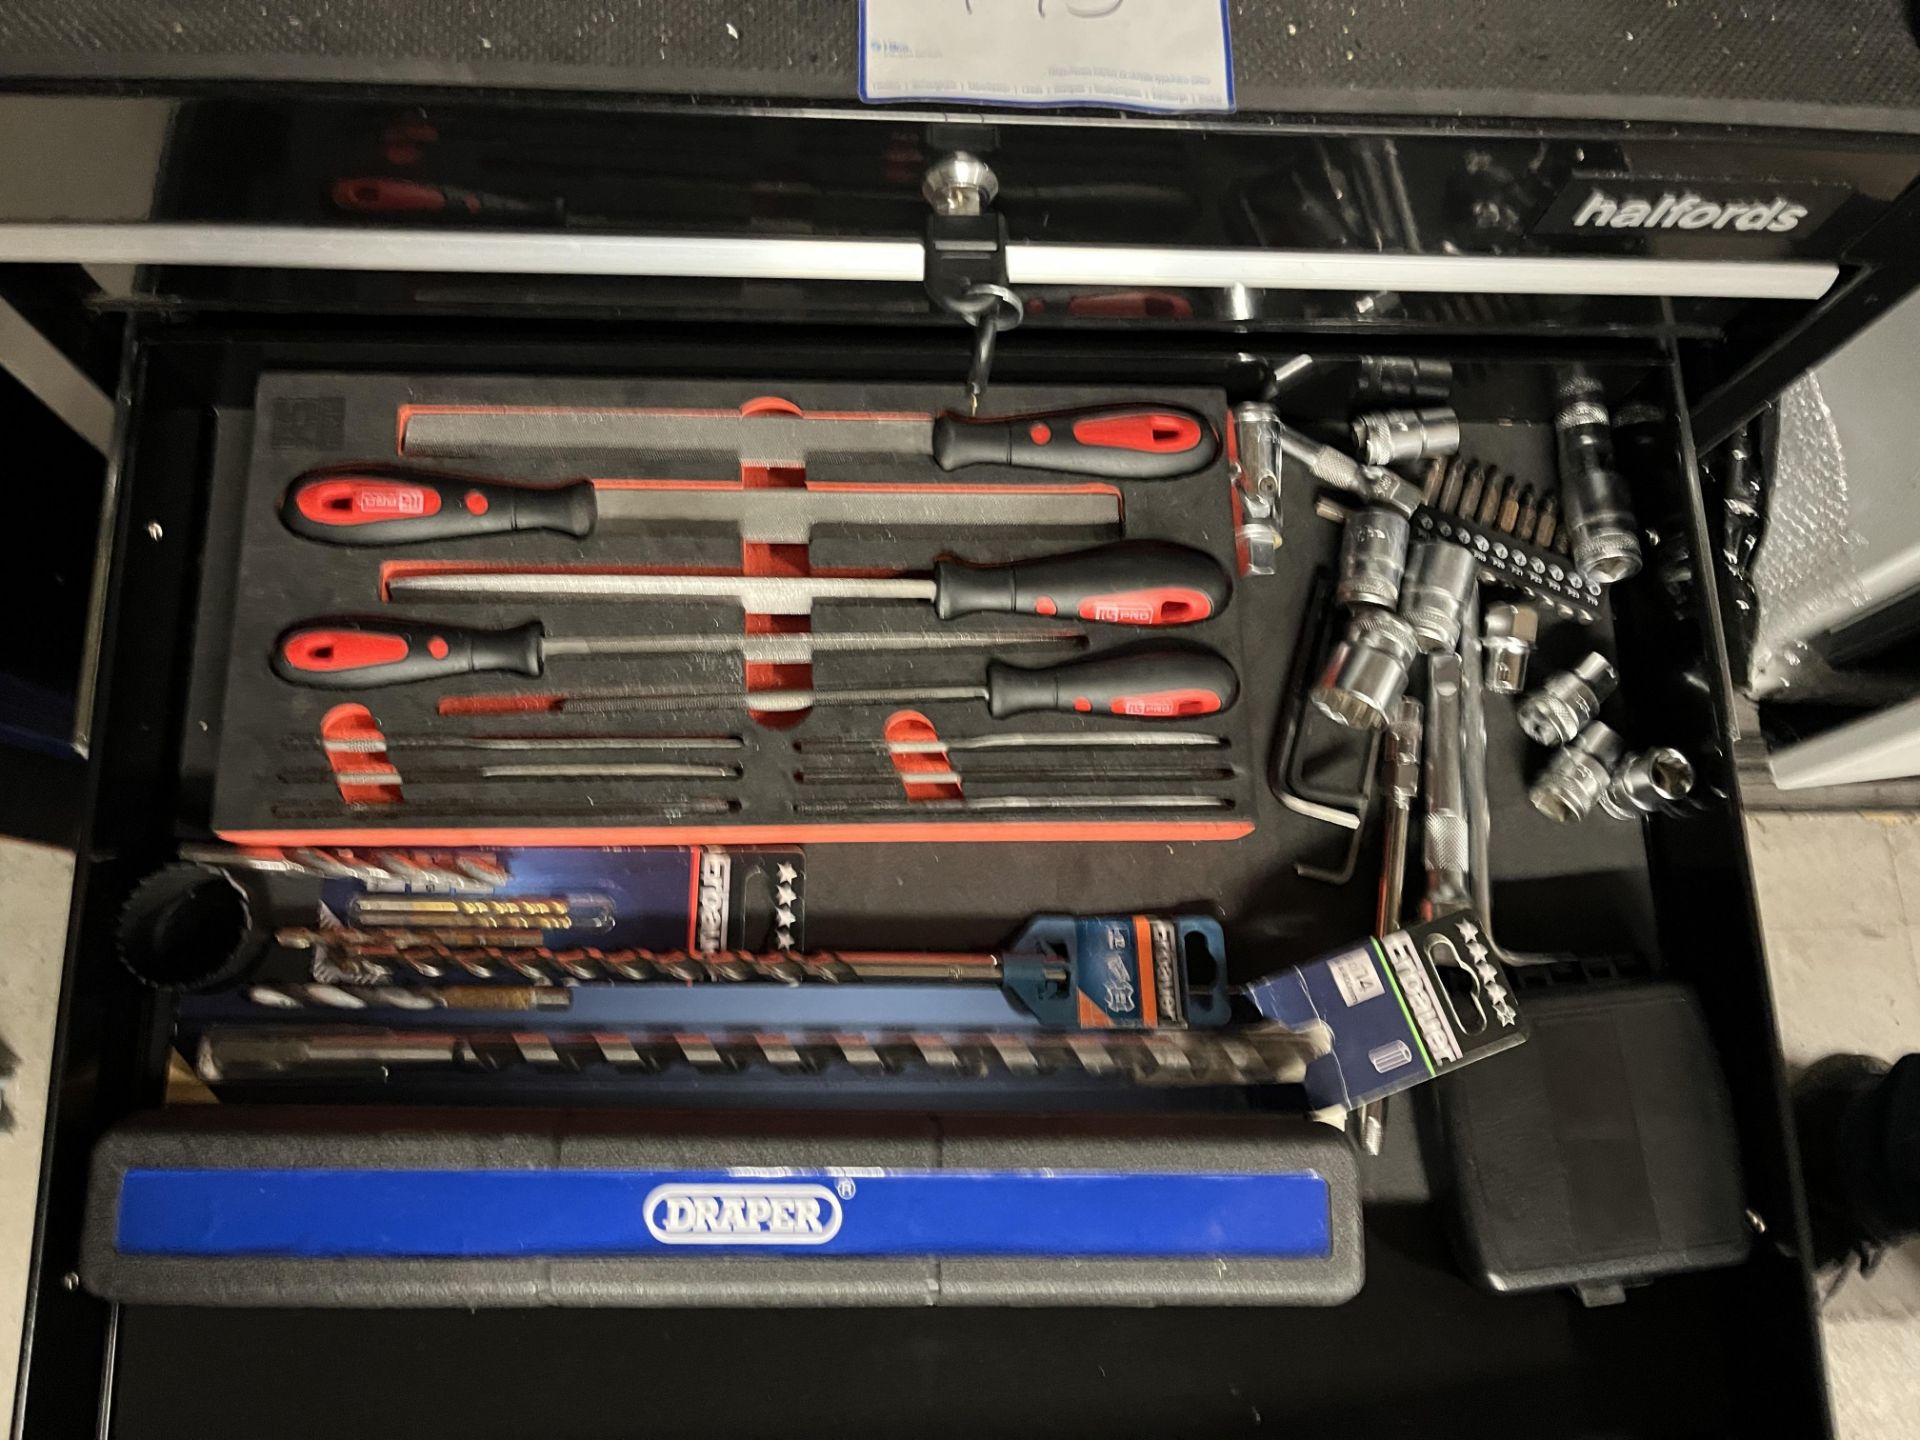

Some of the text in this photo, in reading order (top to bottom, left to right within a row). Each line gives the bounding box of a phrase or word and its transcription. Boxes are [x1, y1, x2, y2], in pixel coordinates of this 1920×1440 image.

[1573, 190, 1808, 232] halfords
[700, 853, 731, 952] Erbau
[1382, 931, 1463, 1066] Erbauer
[662, 1196, 824, 1234] DRAPER
